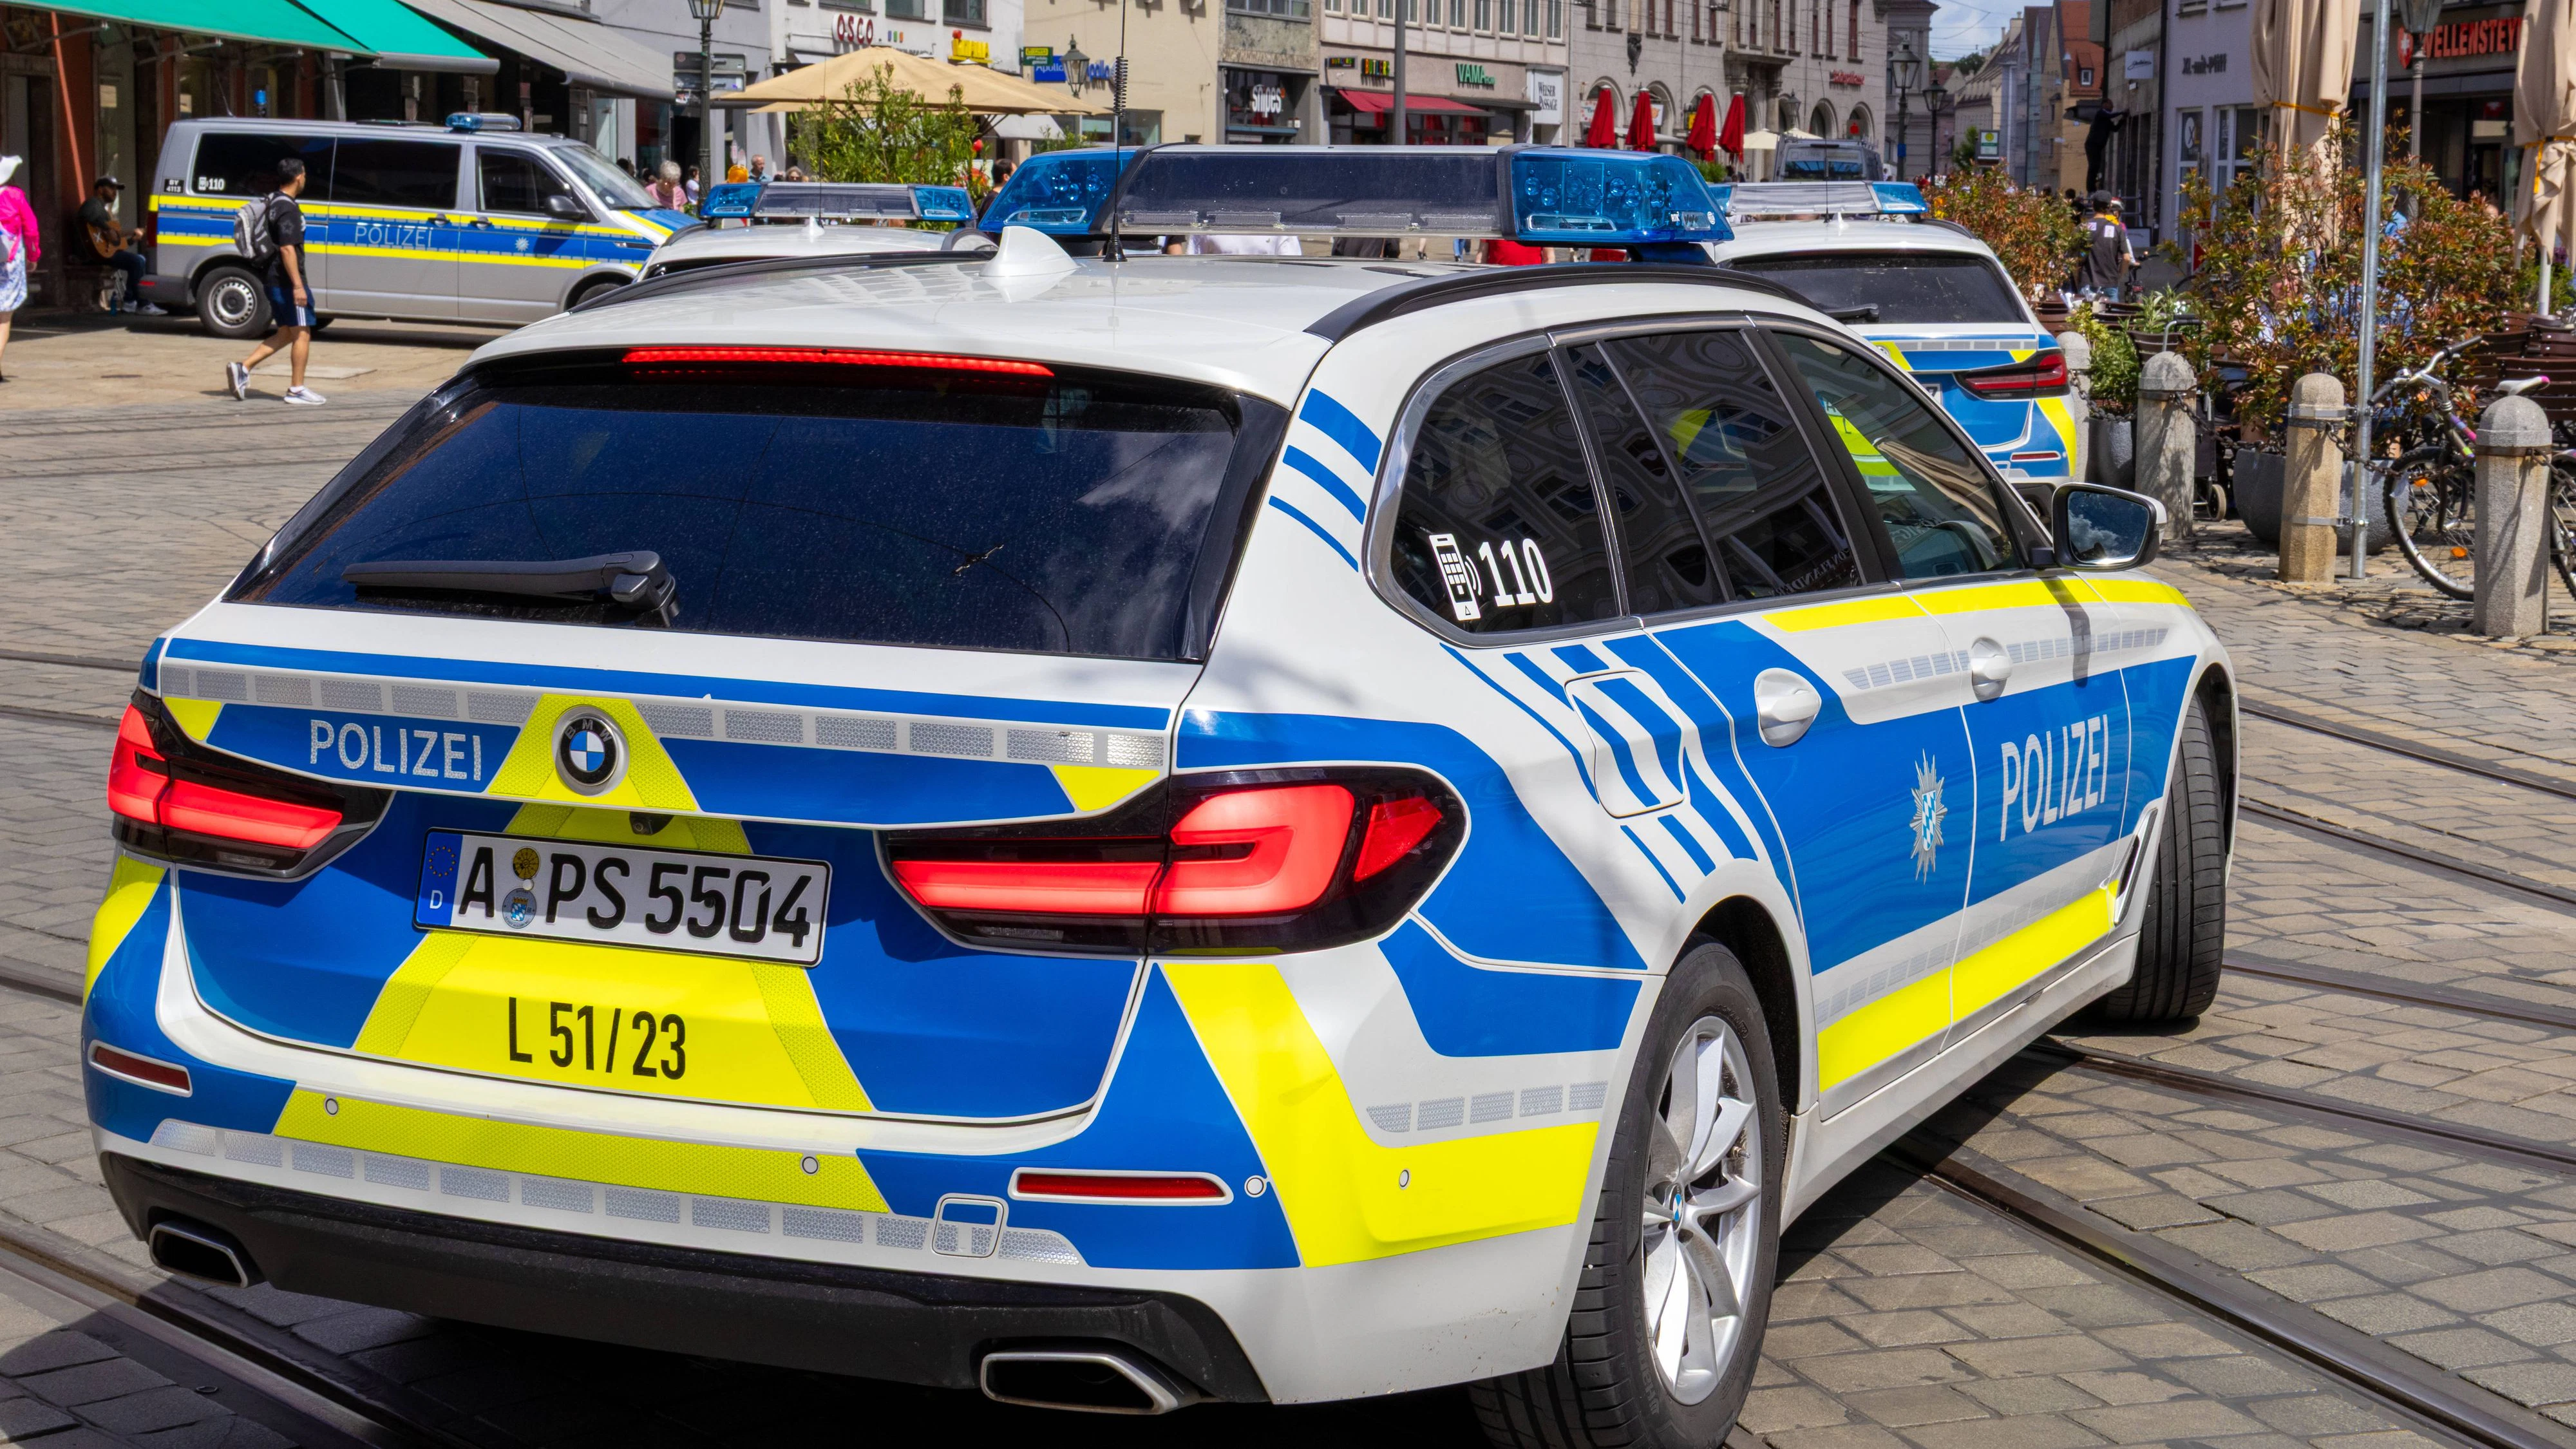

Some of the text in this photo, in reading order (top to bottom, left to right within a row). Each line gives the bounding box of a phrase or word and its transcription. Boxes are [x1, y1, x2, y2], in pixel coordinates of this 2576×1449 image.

[837, 14, 873, 45] OSCO
[1361, 58, 1390, 76] BUTLERS
[1457, 63, 1486, 84] VAMA
[208, 178, 225, 191] 110
[355, 222, 433, 248] POLIZEI
[1479, 538, 1553, 607] 110
[565, 719, 613, 742] BMW
[310, 719, 481, 781] POLIZEI
[2000, 714, 2108, 842] POLIZEI
[430, 889, 443, 910] D
[458, 846, 813, 949] A PS 5504
[509, 996, 533, 1063] L
